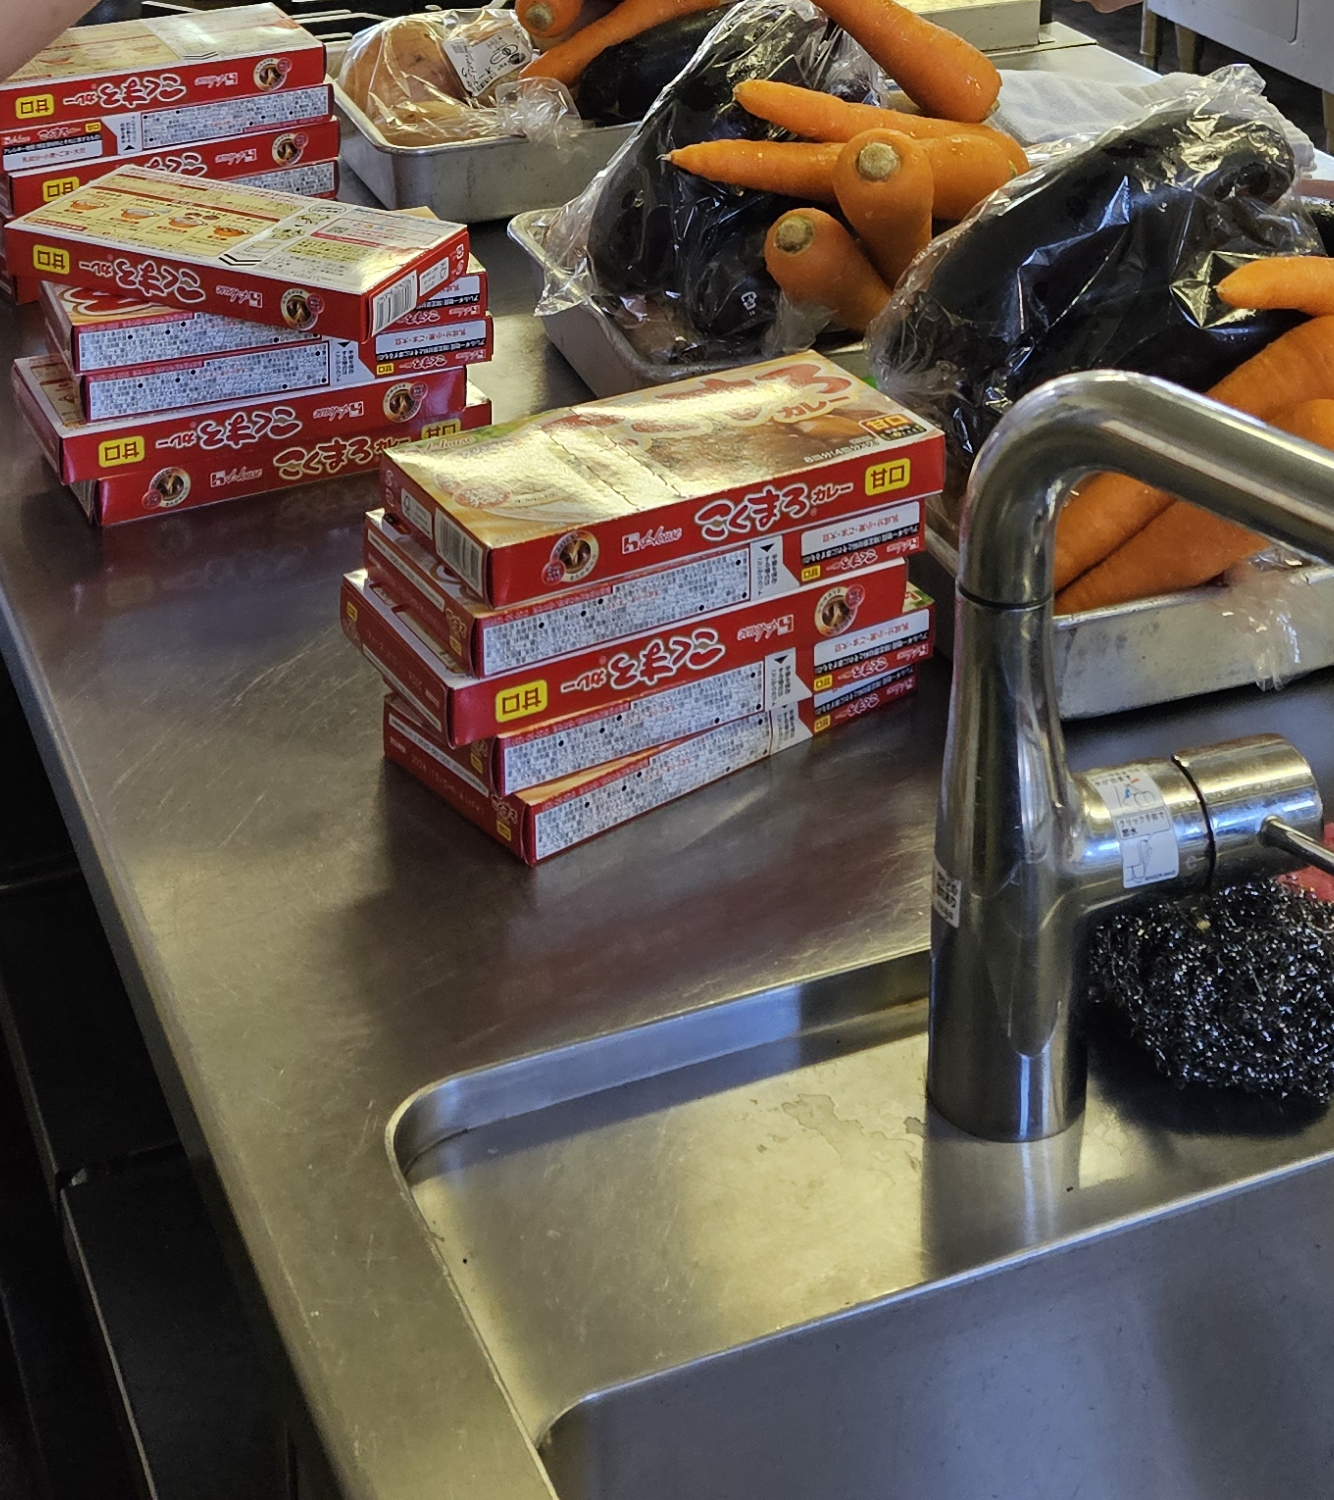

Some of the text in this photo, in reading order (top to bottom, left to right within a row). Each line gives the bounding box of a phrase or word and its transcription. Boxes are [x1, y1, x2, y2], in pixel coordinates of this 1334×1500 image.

[20, 97, 50, 116] 甘口
[37, 250, 65, 270] 甘口
[105, 442, 141, 463] 甘口
[870, 466, 905, 490] 甘口
[502, 687, 541, 714] 甘口
